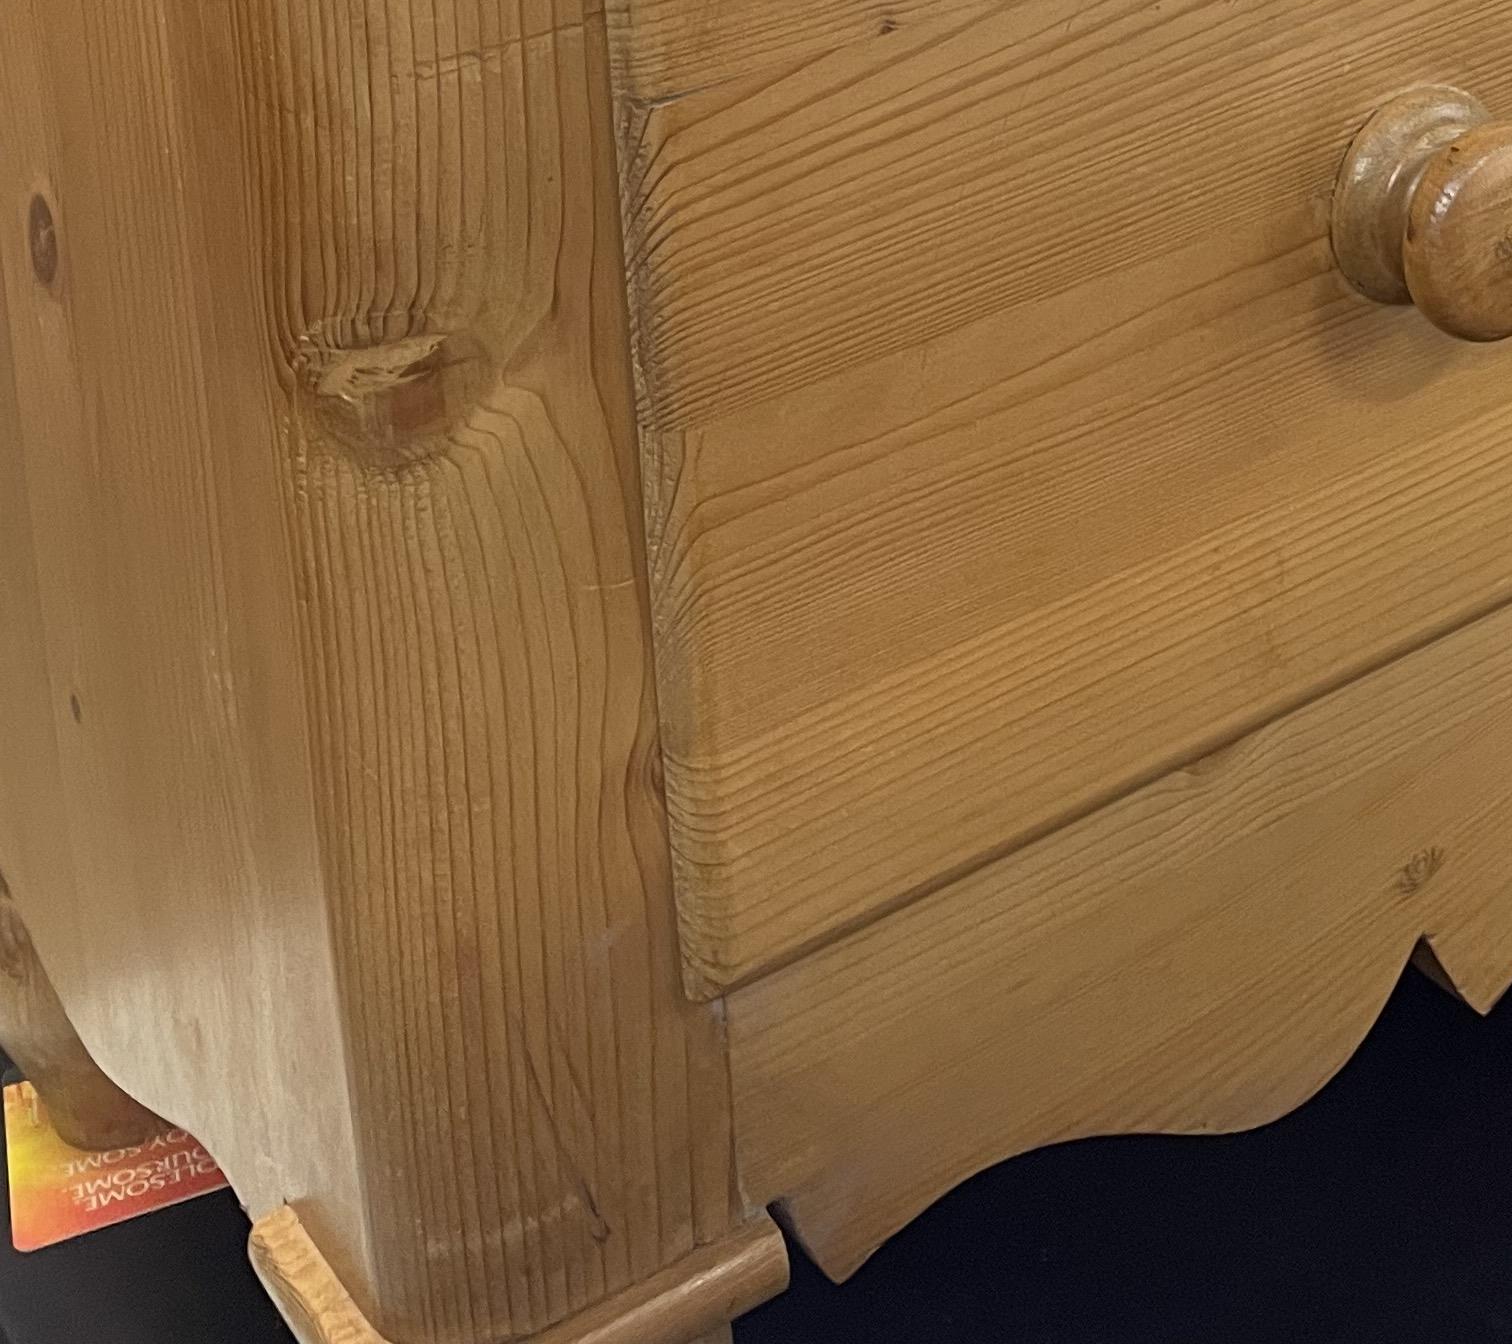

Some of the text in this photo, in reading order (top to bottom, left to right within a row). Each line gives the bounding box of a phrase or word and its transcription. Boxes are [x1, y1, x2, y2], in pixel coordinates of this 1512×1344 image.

[149, 1128, 189, 1150] OY
[62, 1147, 213, 1199] OURSOME.
[74, 1162, 219, 1211] OLESOME.
